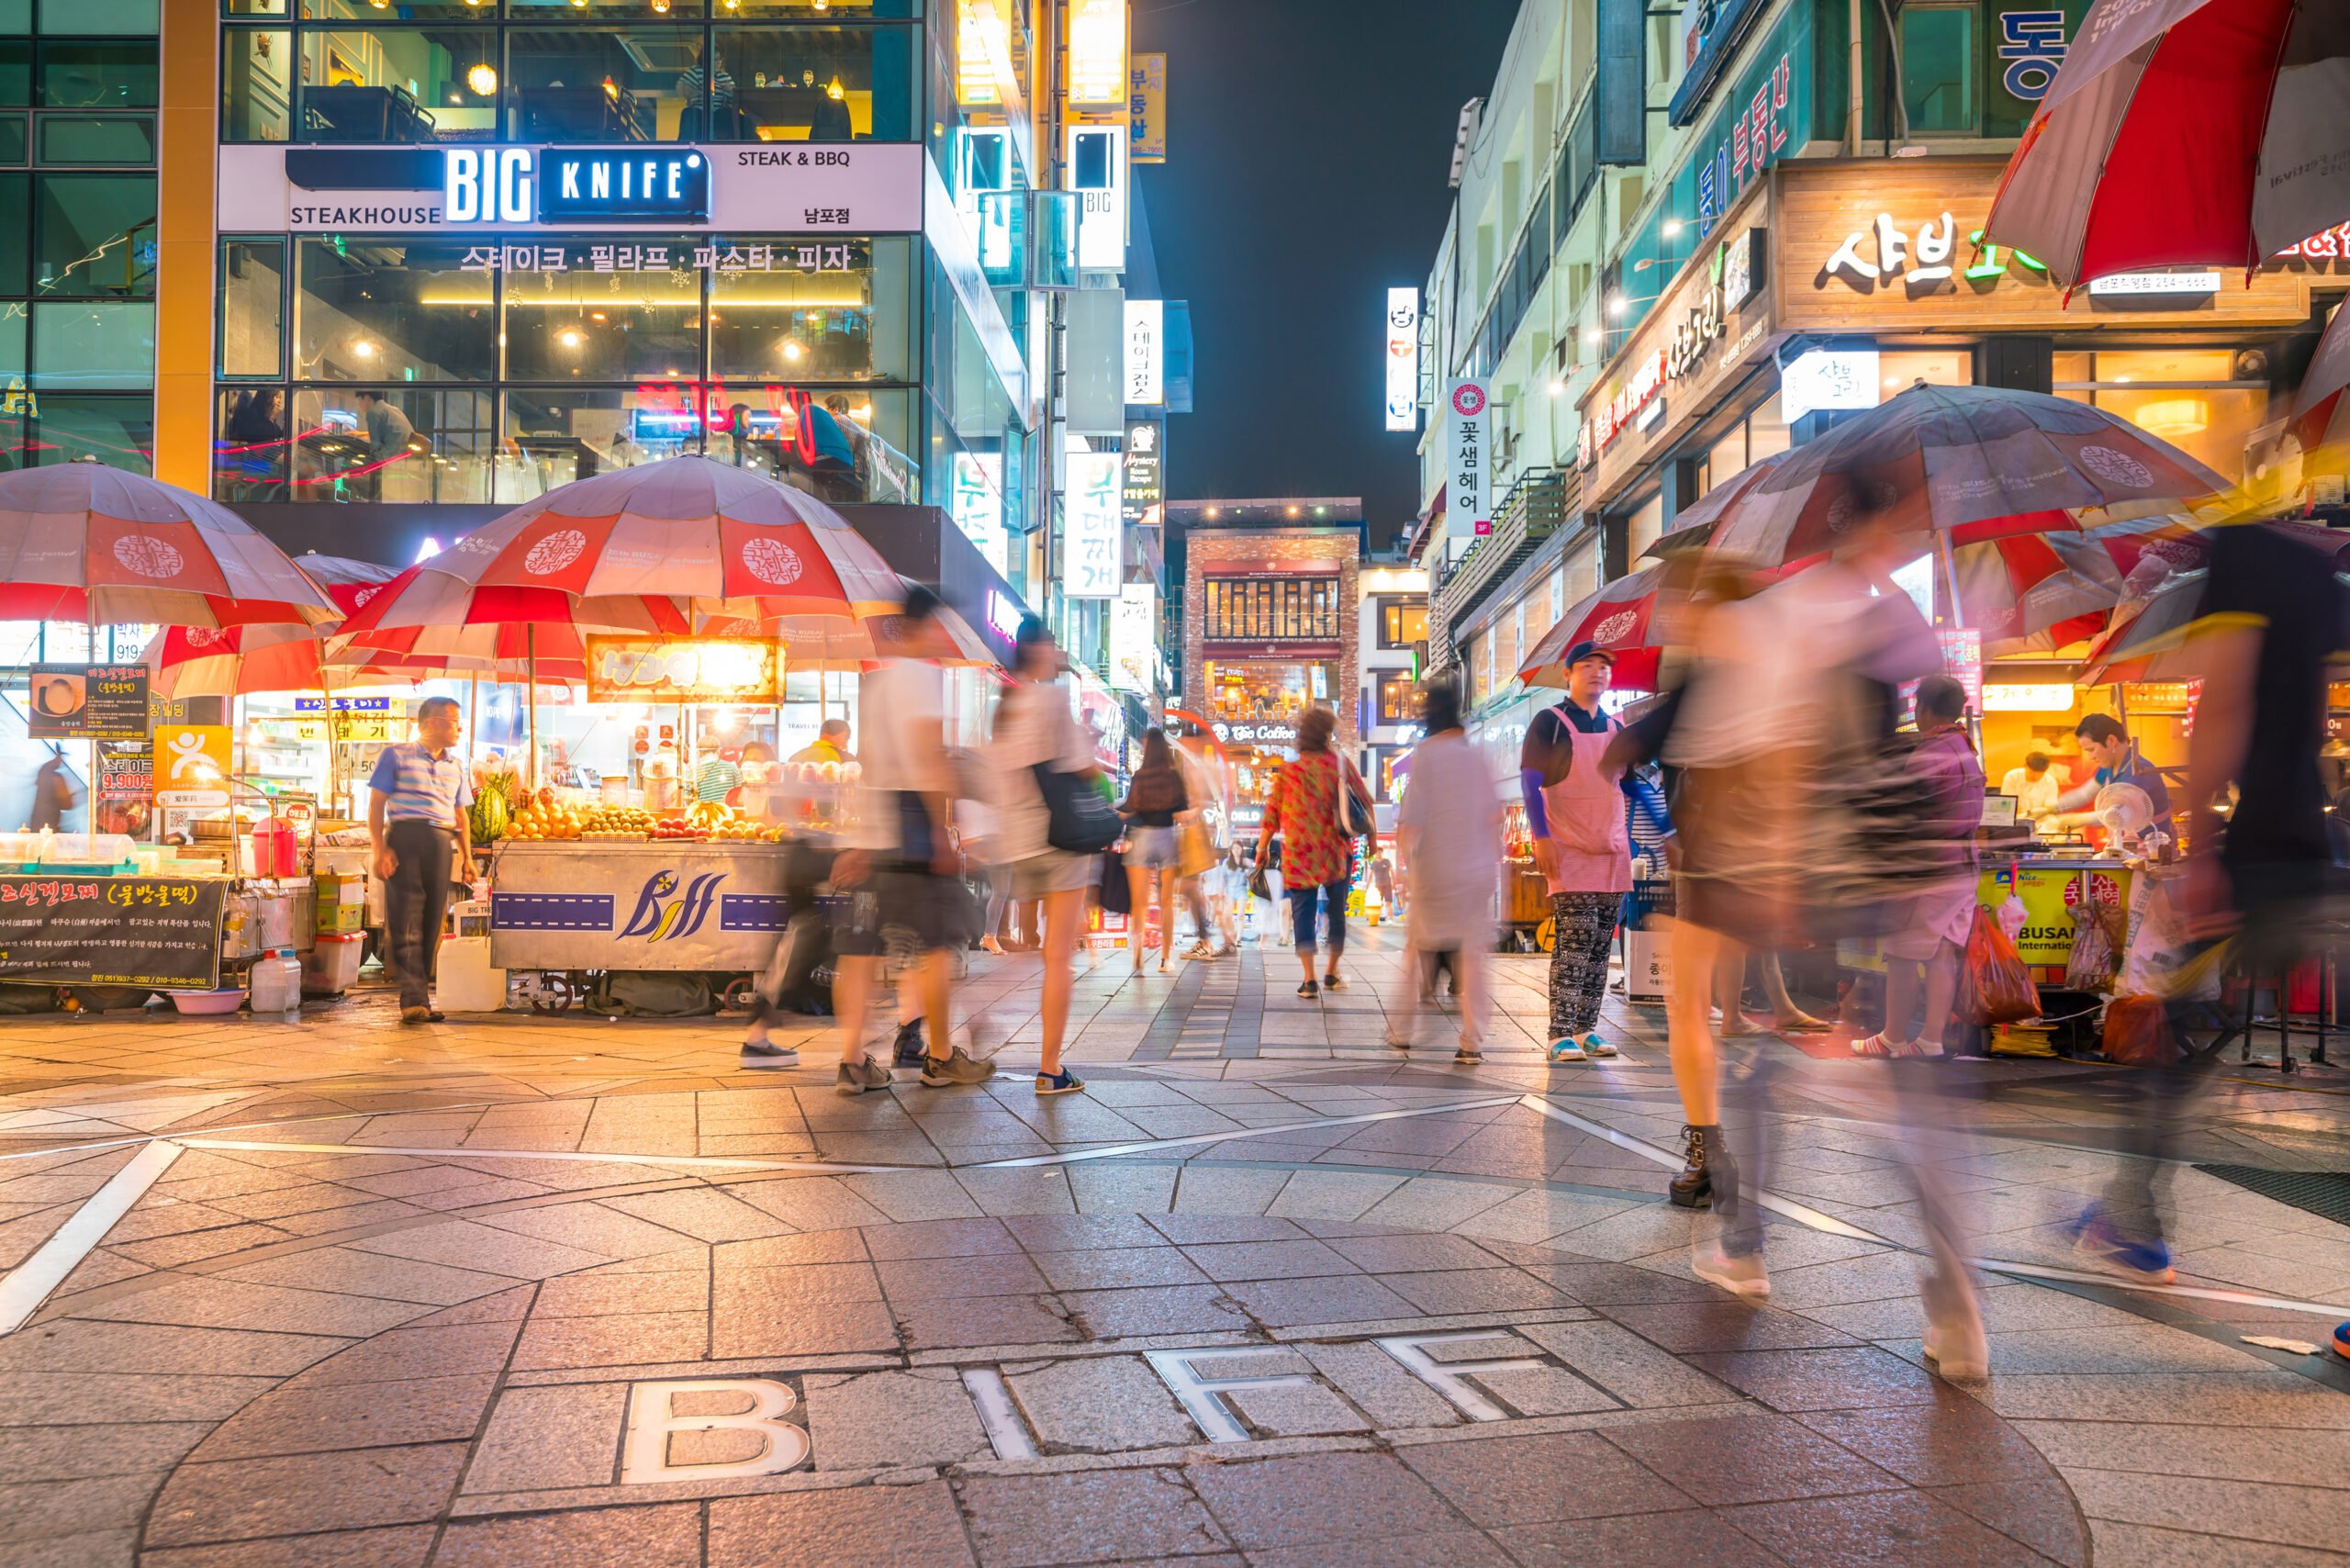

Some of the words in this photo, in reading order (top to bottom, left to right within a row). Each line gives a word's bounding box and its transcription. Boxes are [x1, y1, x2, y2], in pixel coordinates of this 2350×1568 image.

[1131, 69, 1147, 143] 부동산
[1733, 52, 1789, 195] 부동산
[737, 151, 792, 167] STEAK
[797, 151, 810, 167] &
[813, 151, 851, 168] BBQ
[446, 148, 533, 222] BIG
[561, 162, 683, 200] KNIFE
[1086, 192, 1112, 213] BIG
[290, 207, 442, 226] STEAKHOUSE
[803, 207, 850, 226] 남포점
[460, 244, 567, 274] 스테이크
[590, 244, 671, 274] 필라프
[693, 244, 774, 274] 파스타
[796, 244, 851, 274] 피자
[1665, 283, 1723, 379] 샤브그린
[1818, 360, 1851, 380] 샤브
[1832, 380, 1863, 398] 그린
[1461, 395, 1477, 404] 꽃샘
[1459, 421, 1480, 514] 꽃샘헤어
[1477, 523, 1488, 532] 3F
[1231, 725, 1255, 741] The
[1257, 724, 1296, 740] Coffee
[1230, 811, 1260, 822] ORLD
[0, 880, 99, 907] 즈신겐모찌
[107, 883, 198, 907] (물방울떡)
[2019, 941, 2072, 950] Internatio
[620, 1328, 1551, 1486] BIFF
